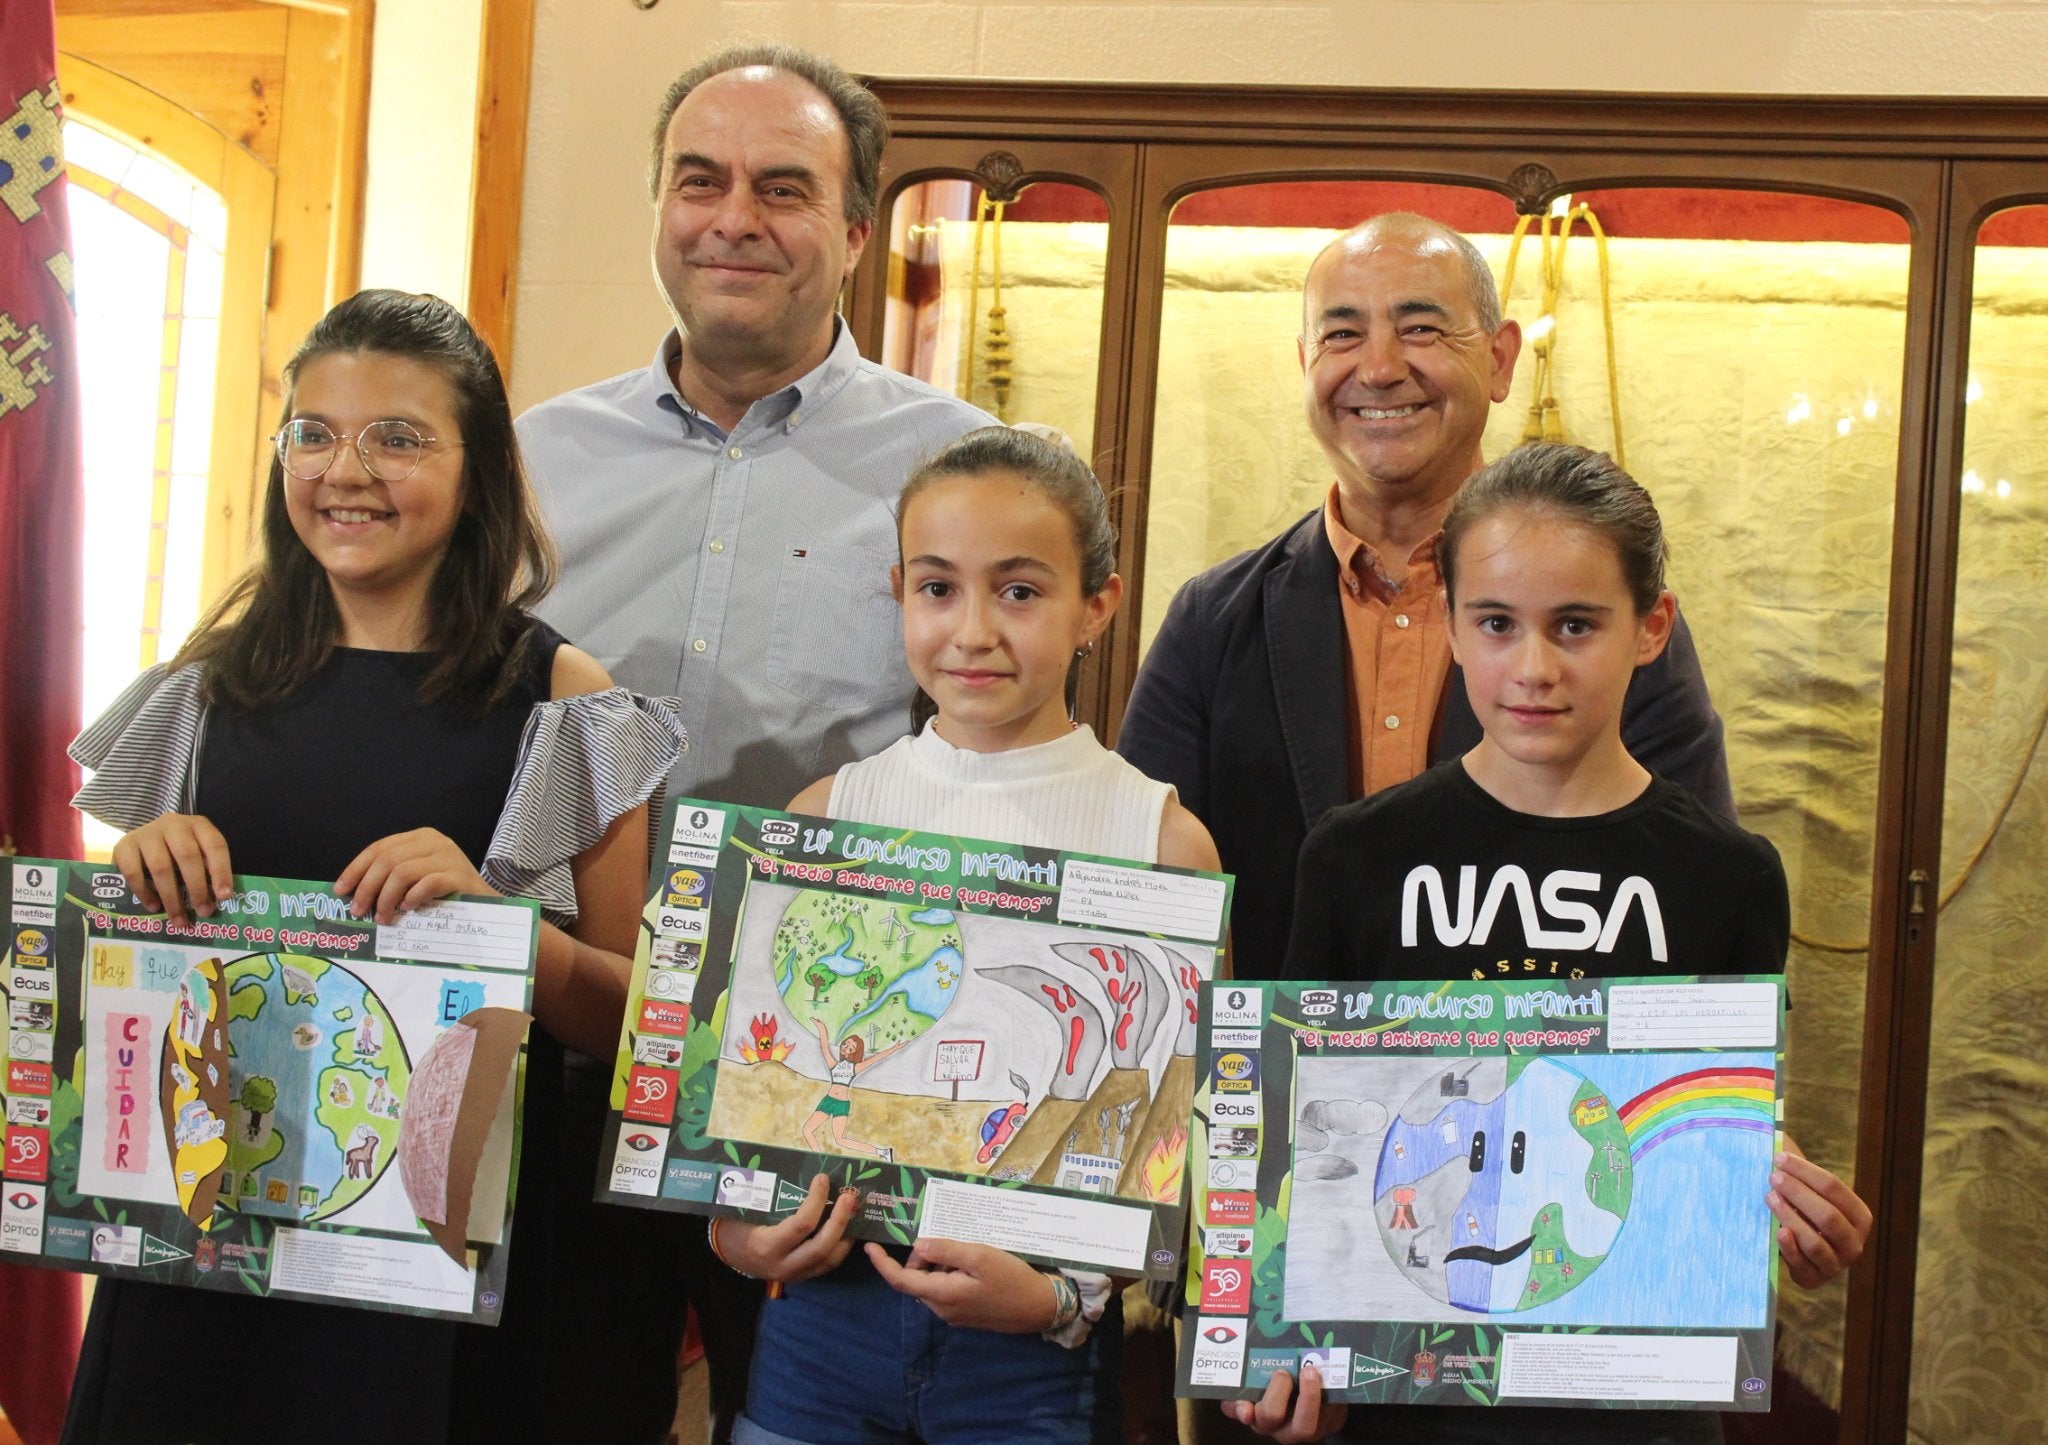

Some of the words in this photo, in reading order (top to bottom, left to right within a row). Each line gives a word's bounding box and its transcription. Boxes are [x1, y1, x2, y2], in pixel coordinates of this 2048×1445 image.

[676, 828, 718, 840] MOLINA
[766, 823, 793, 833] ONDA
[766, 835, 791, 843] CERO
[765, 847, 784, 856] YECLA
[95, 877, 121, 885] ONDA
[674, 874, 705, 889] yago
[783, 863, 833, 882] medio
[836, 869, 916, 894] ambiente
[919, 882, 951, 900] que
[15, 888, 53, 898] MOLINA
[97, 887, 120, 896] CERO
[1402, 864, 1668, 963] NASA
[117, 915, 162, 933] medio
[243, 926, 274, 943] que
[661, 915, 702, 931] ecus
[19, 935, 48, 950] yago
[92, 948, 126, 986] Hay
[147, 957, 179, 987] que
[14, 976, 50, 991] ecus
[444, 989, 469, 1021] El
[1328, 1031, 1378, 1047] medio
[1382, 1031, 1461, 1047] ambiente
[1466, 1031, 1500, 1047] que
[942, 1045, 958, 1053] HAY
[960, 1045, 976, 1054] QUE
[940, 1054, 970, 1065] SALVAR
[950, 1064, 960, 1074] EL
[1220, 1060, 1252, 1073] yago
[114, 1017, 138, 1168] CUIDAR
[1214, 1102, 1255, 1116] ecus
[617, 1155, 660, 1168] FRANCISCO
[1216, 1232, 1246, 1240] altiplano
[1196, 1349, 1240, 1359] FRANCISCO
